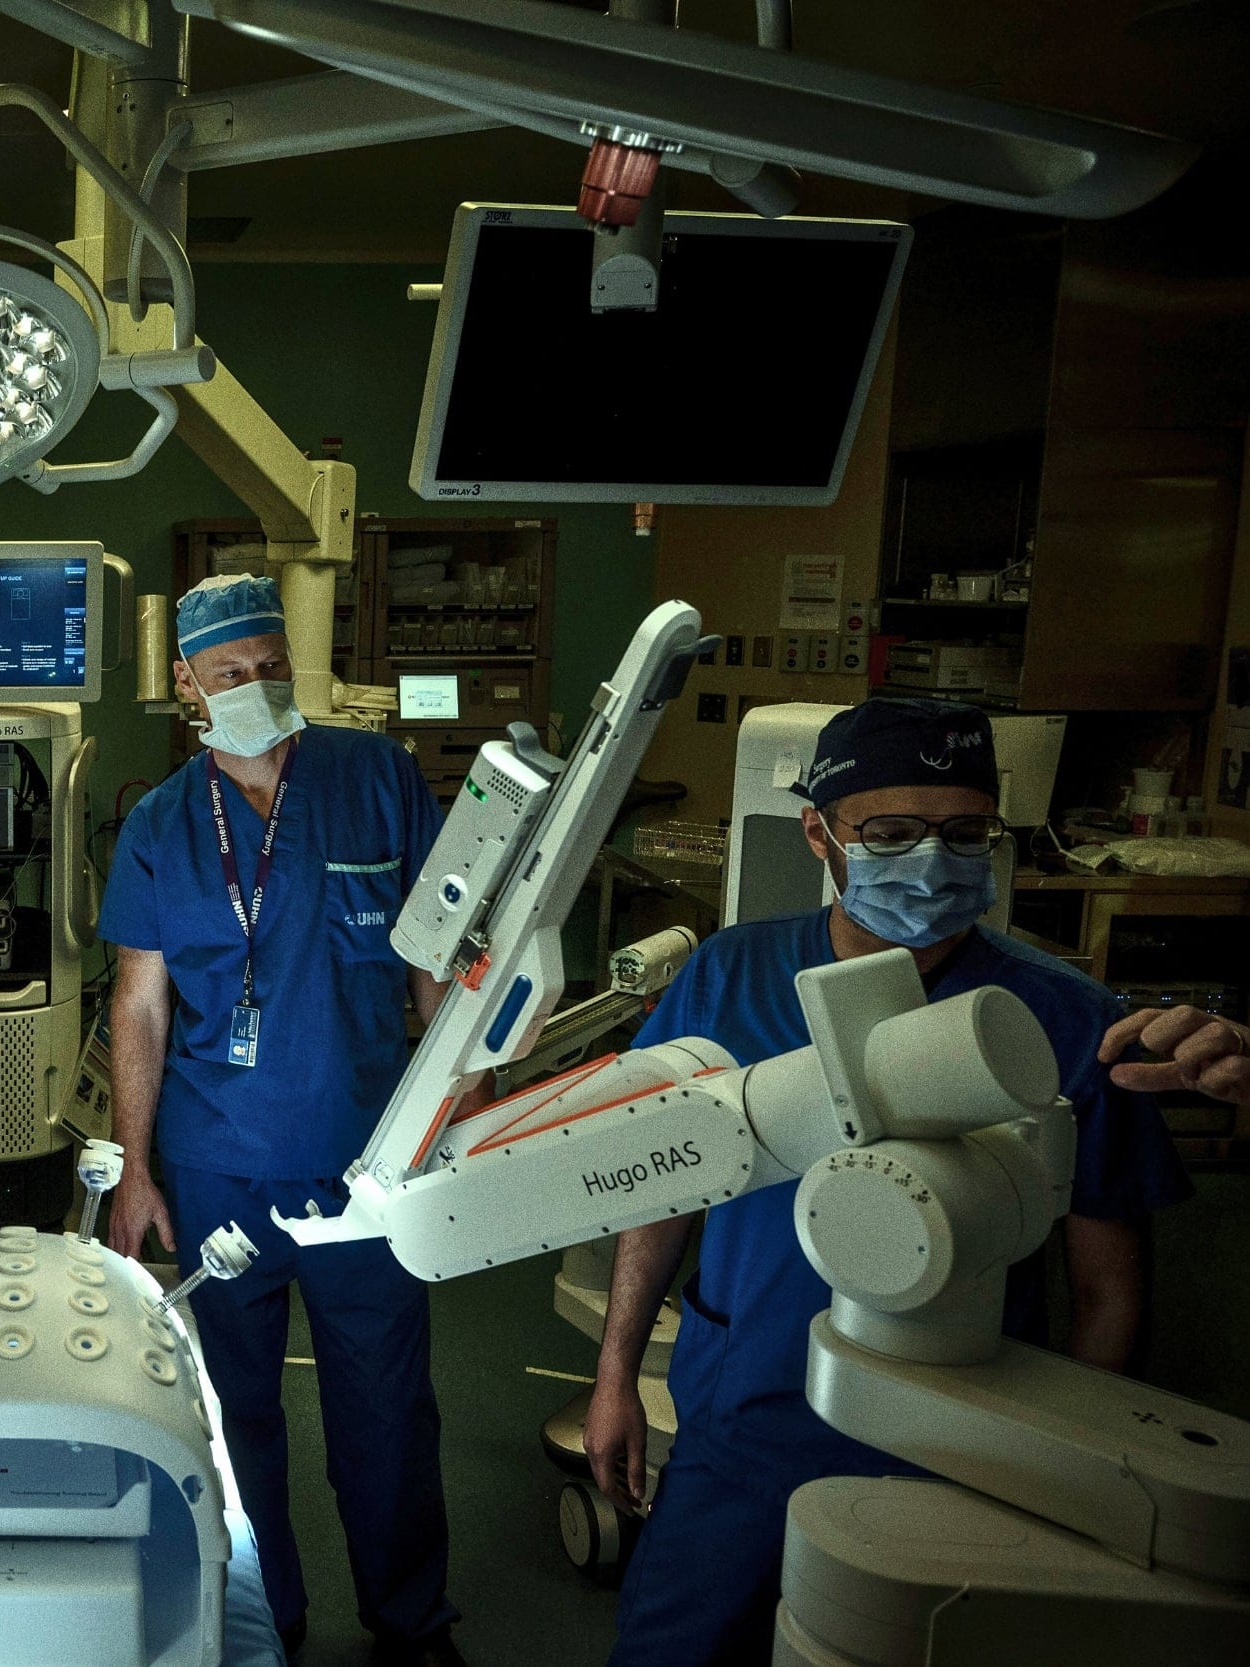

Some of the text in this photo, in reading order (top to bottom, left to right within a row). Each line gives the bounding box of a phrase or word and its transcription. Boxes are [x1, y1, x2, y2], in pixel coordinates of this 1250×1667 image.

[438, 483, 481, 496] DISPLAY 3
[4, 725, 24, 736] RAS
[210, 779, 230, 854] General Surgery
[261, 781, 288, 857] General Surgery
[232, 900, 248, 927] UHN
[250, 897, 262, 925] UHN
[357, 911, 385, 926] UHN
[582, 1140, 702, 1197] Hugo RAS
